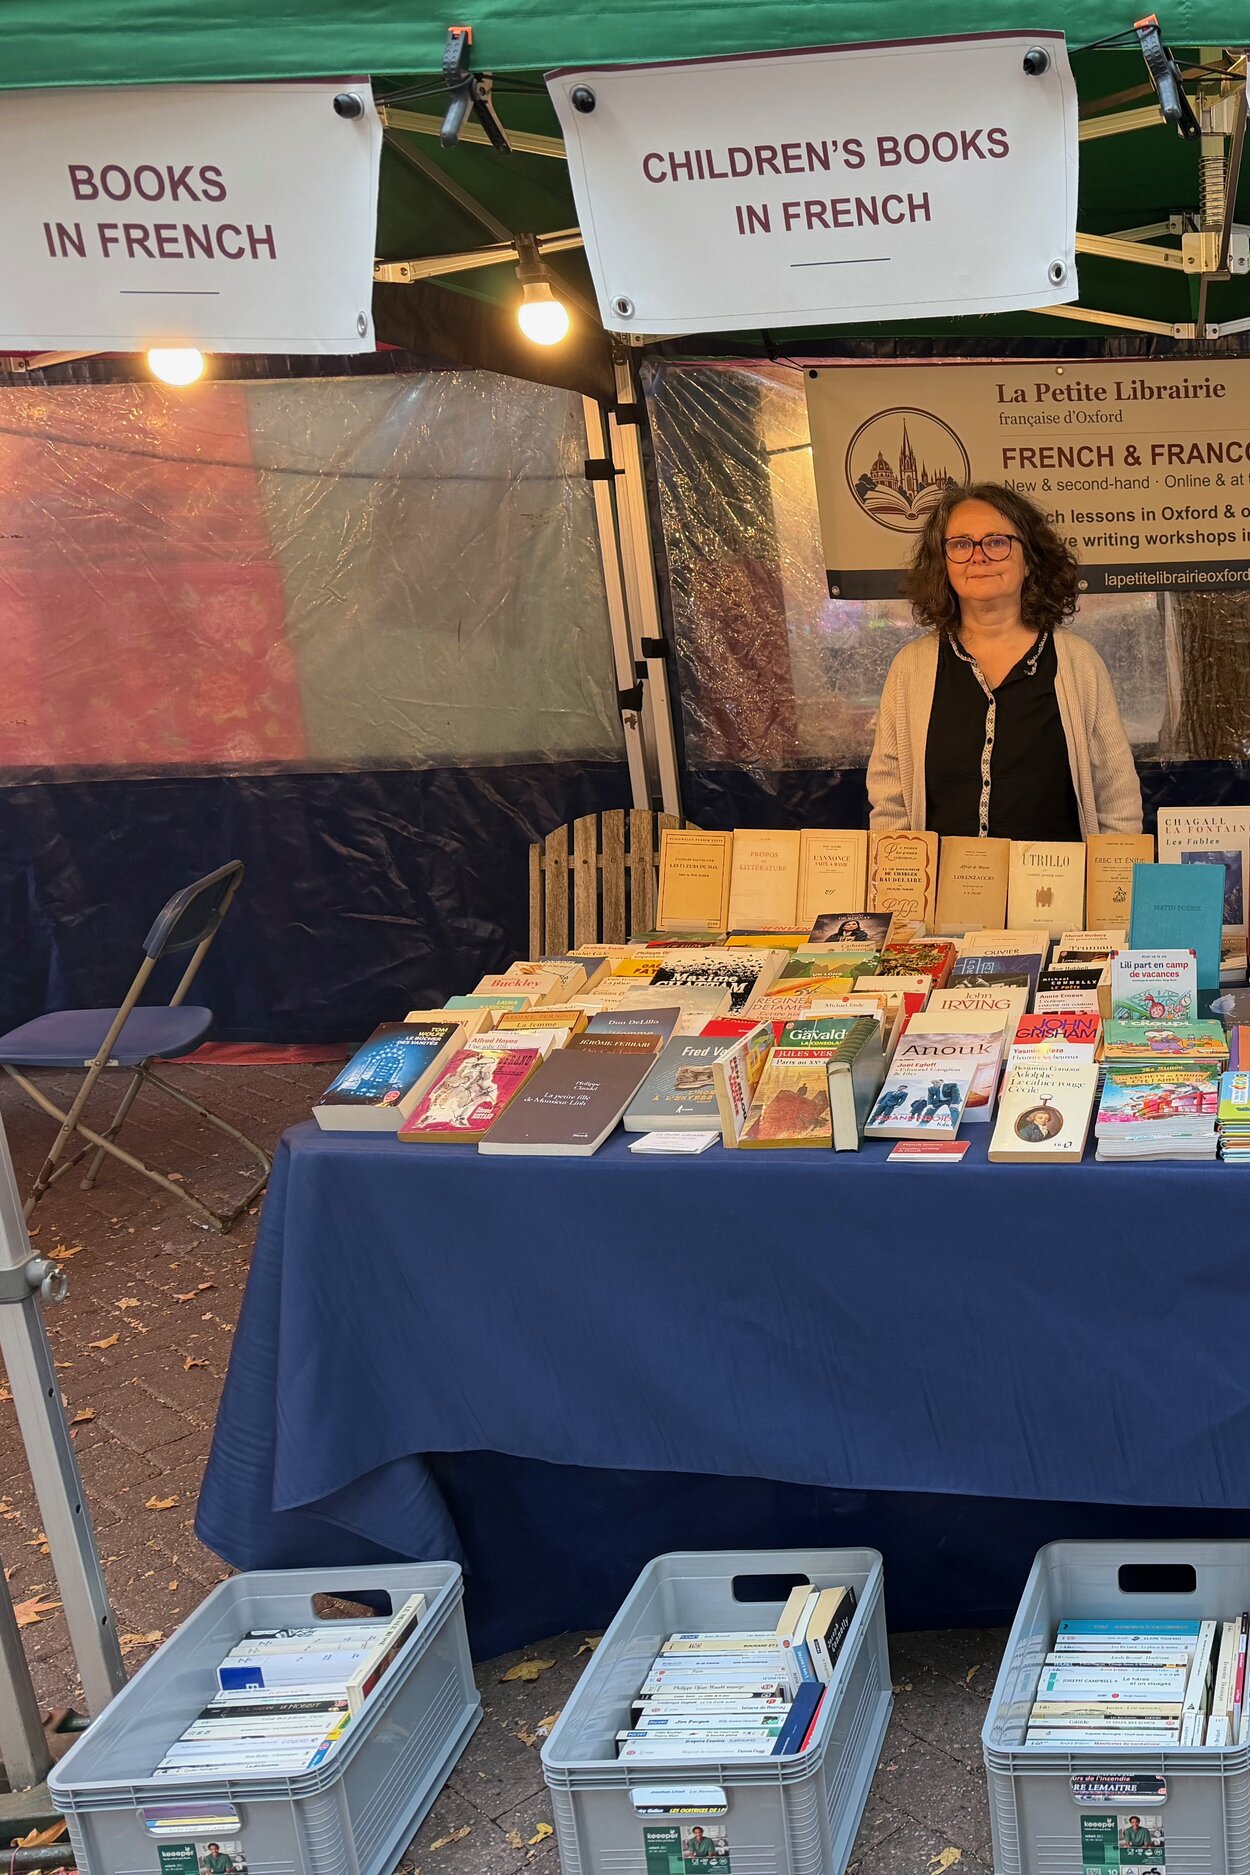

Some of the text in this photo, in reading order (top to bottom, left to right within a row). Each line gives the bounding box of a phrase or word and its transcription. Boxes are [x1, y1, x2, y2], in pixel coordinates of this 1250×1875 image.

[641, 128, 1010, 186] CHILDREN’S BOOKS
[67, 163, 228, 203] BOOKS
[735, 192, 933, 236] IN FRENCH
[44, 222, 278, 261] IN FRENCH
[995, 377, 1226, 404] La Petite Librairie
[999, 412, 1060, 427] française
[1001, 443, 1116, 471] FRENCH
[1123, 442, 1144, 467] &
[1004, 479, 1037, 493] New
[1041, 478, 1052, 491] &
[1057, 476, 1150, 491] second-hand
[1164, 474, 1201, 488] Online
[1216, 474, 1226, 487] &
[1231, 473, 1244, 487] at
[1071, 508, 1135, 524] lessons
[1141, 507, 1156, 521] in
[1161, 505, 1218, 521] Oxford
[1224, 505, 1236, 518] &
[1083, 533, 1139, 550] writing
[1145, 528, 1237, 547] workshops
[1165, 817, 1226, 826] CHAGALL
[1165, 826, 1181, 834] LA
[1166, 837, 1220, 846] Les Fables
[1022, 854, 1070, 867] UTRILLO
[1119, 960, 1132, 969] Lili
[1134, 961, 1152, 971] part
[1166, 961, 1189, 971] camp
[671, 973, 738, 983] Maxime
[1129, 970, 1140, 978] de
[490, 978, 541, 988] Buckley
[941, 1000, 1011, 1010] IRVING
[1034, 1018, 1093, 1030] JOHN
[1015, 1029, 1097, 1039] GRISHAM
[682, 1046, 710, 1056] Fred
[901, 1043, 993, 1055] Anouk
